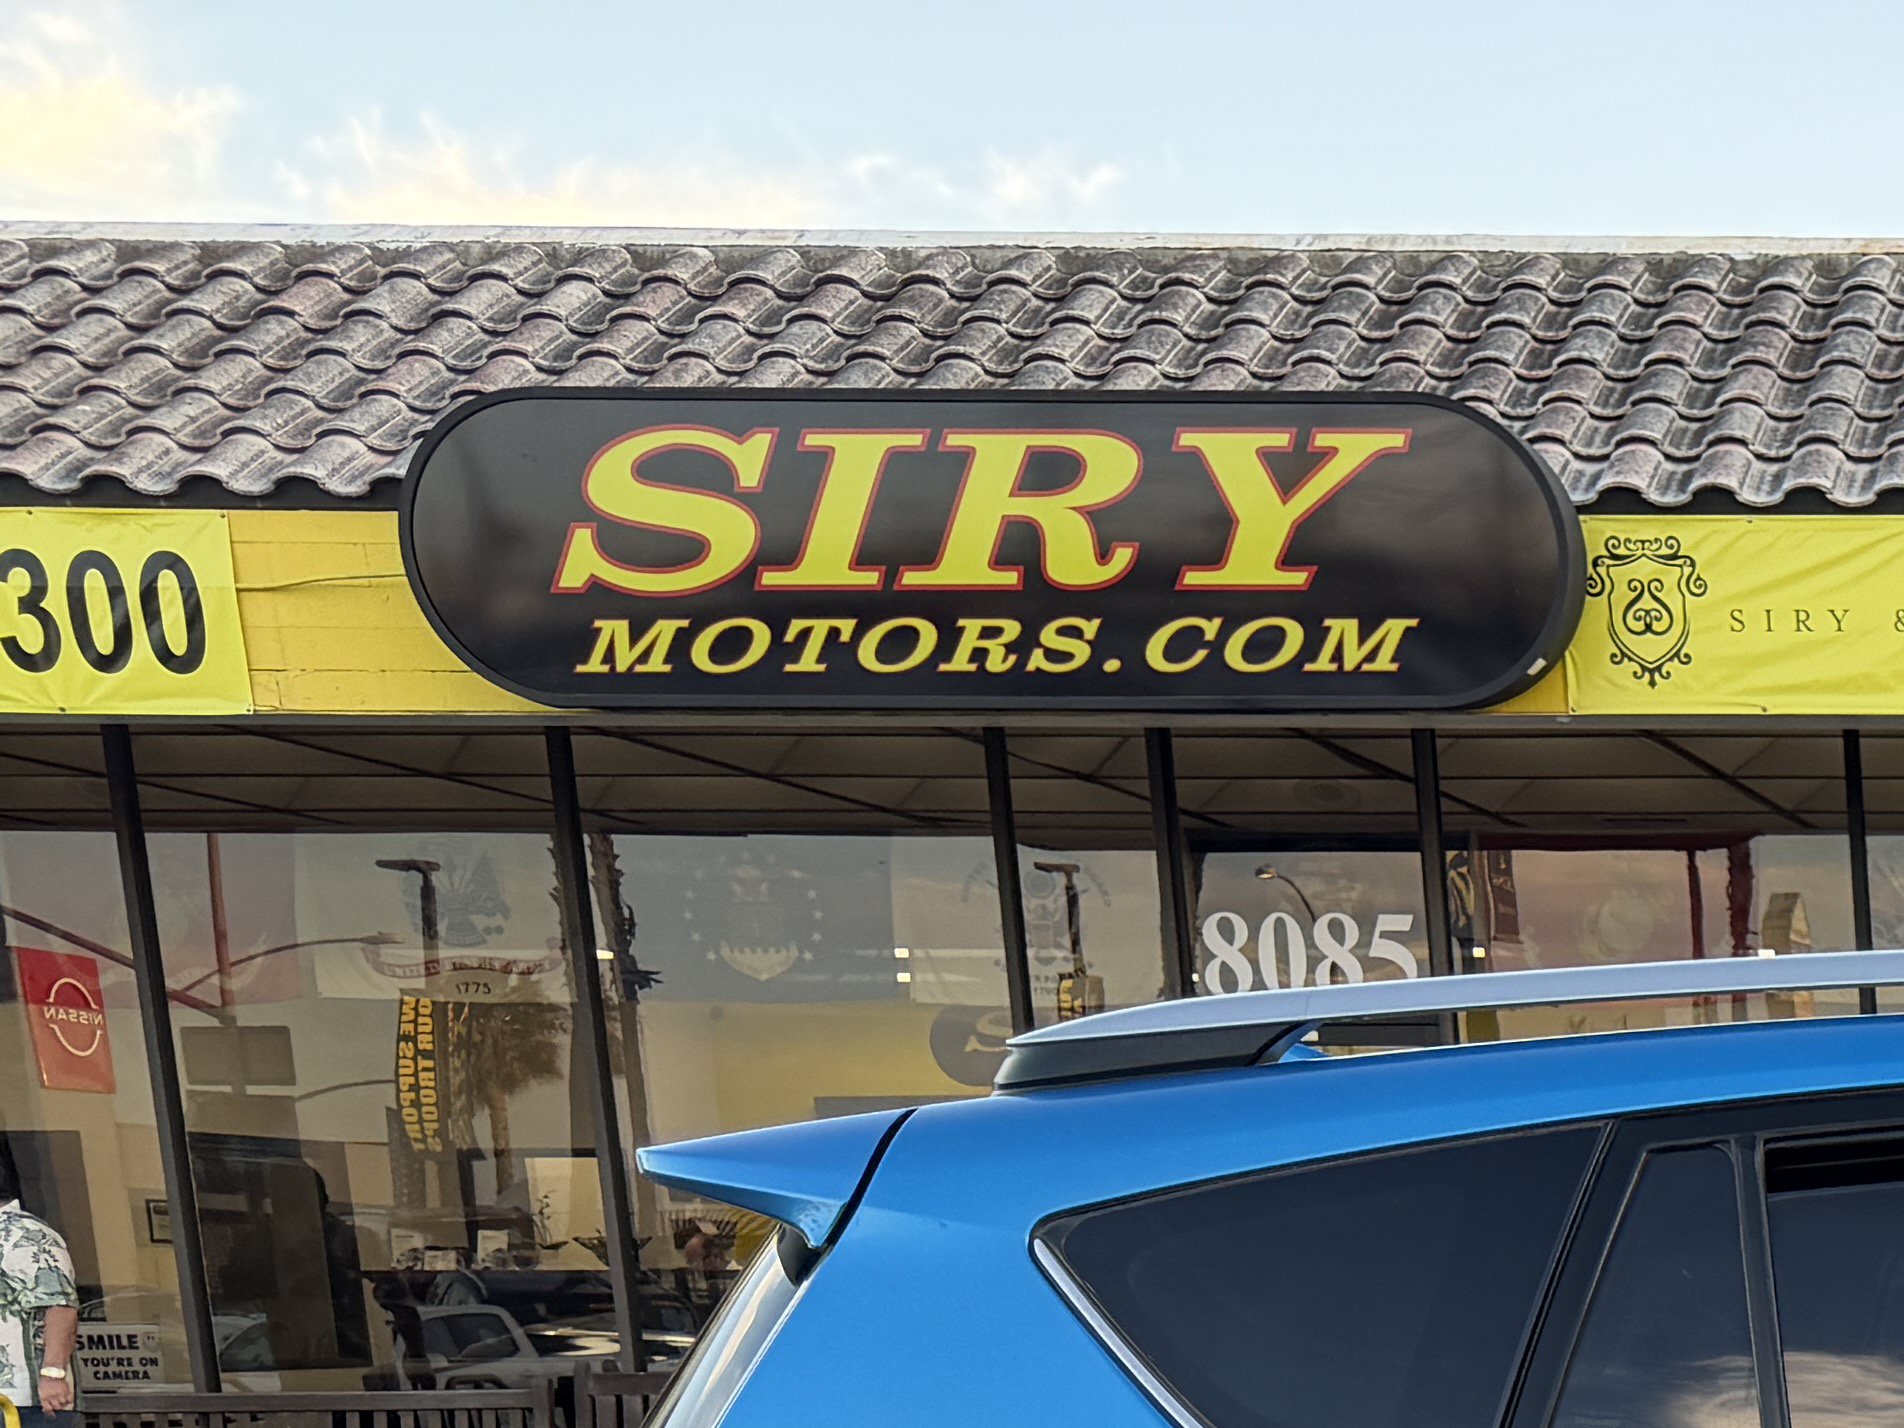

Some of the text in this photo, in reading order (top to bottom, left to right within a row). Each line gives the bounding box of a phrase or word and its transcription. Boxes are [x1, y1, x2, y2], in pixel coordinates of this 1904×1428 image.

[550, 424, 1412, 597] SIRY
[0, 549, 206, 675] 300
[1730, 608, 1851, 634] SIRY
[573, 616, 1421, 676] MOTORS.COM
[1202, 911, 1419, 996] 8085
[75, 1334, 139, 1350] SMILE
[80, 1356, 158, 1368] YOU'RE ON
[93, 1369, 151, 1380] CAMERA
